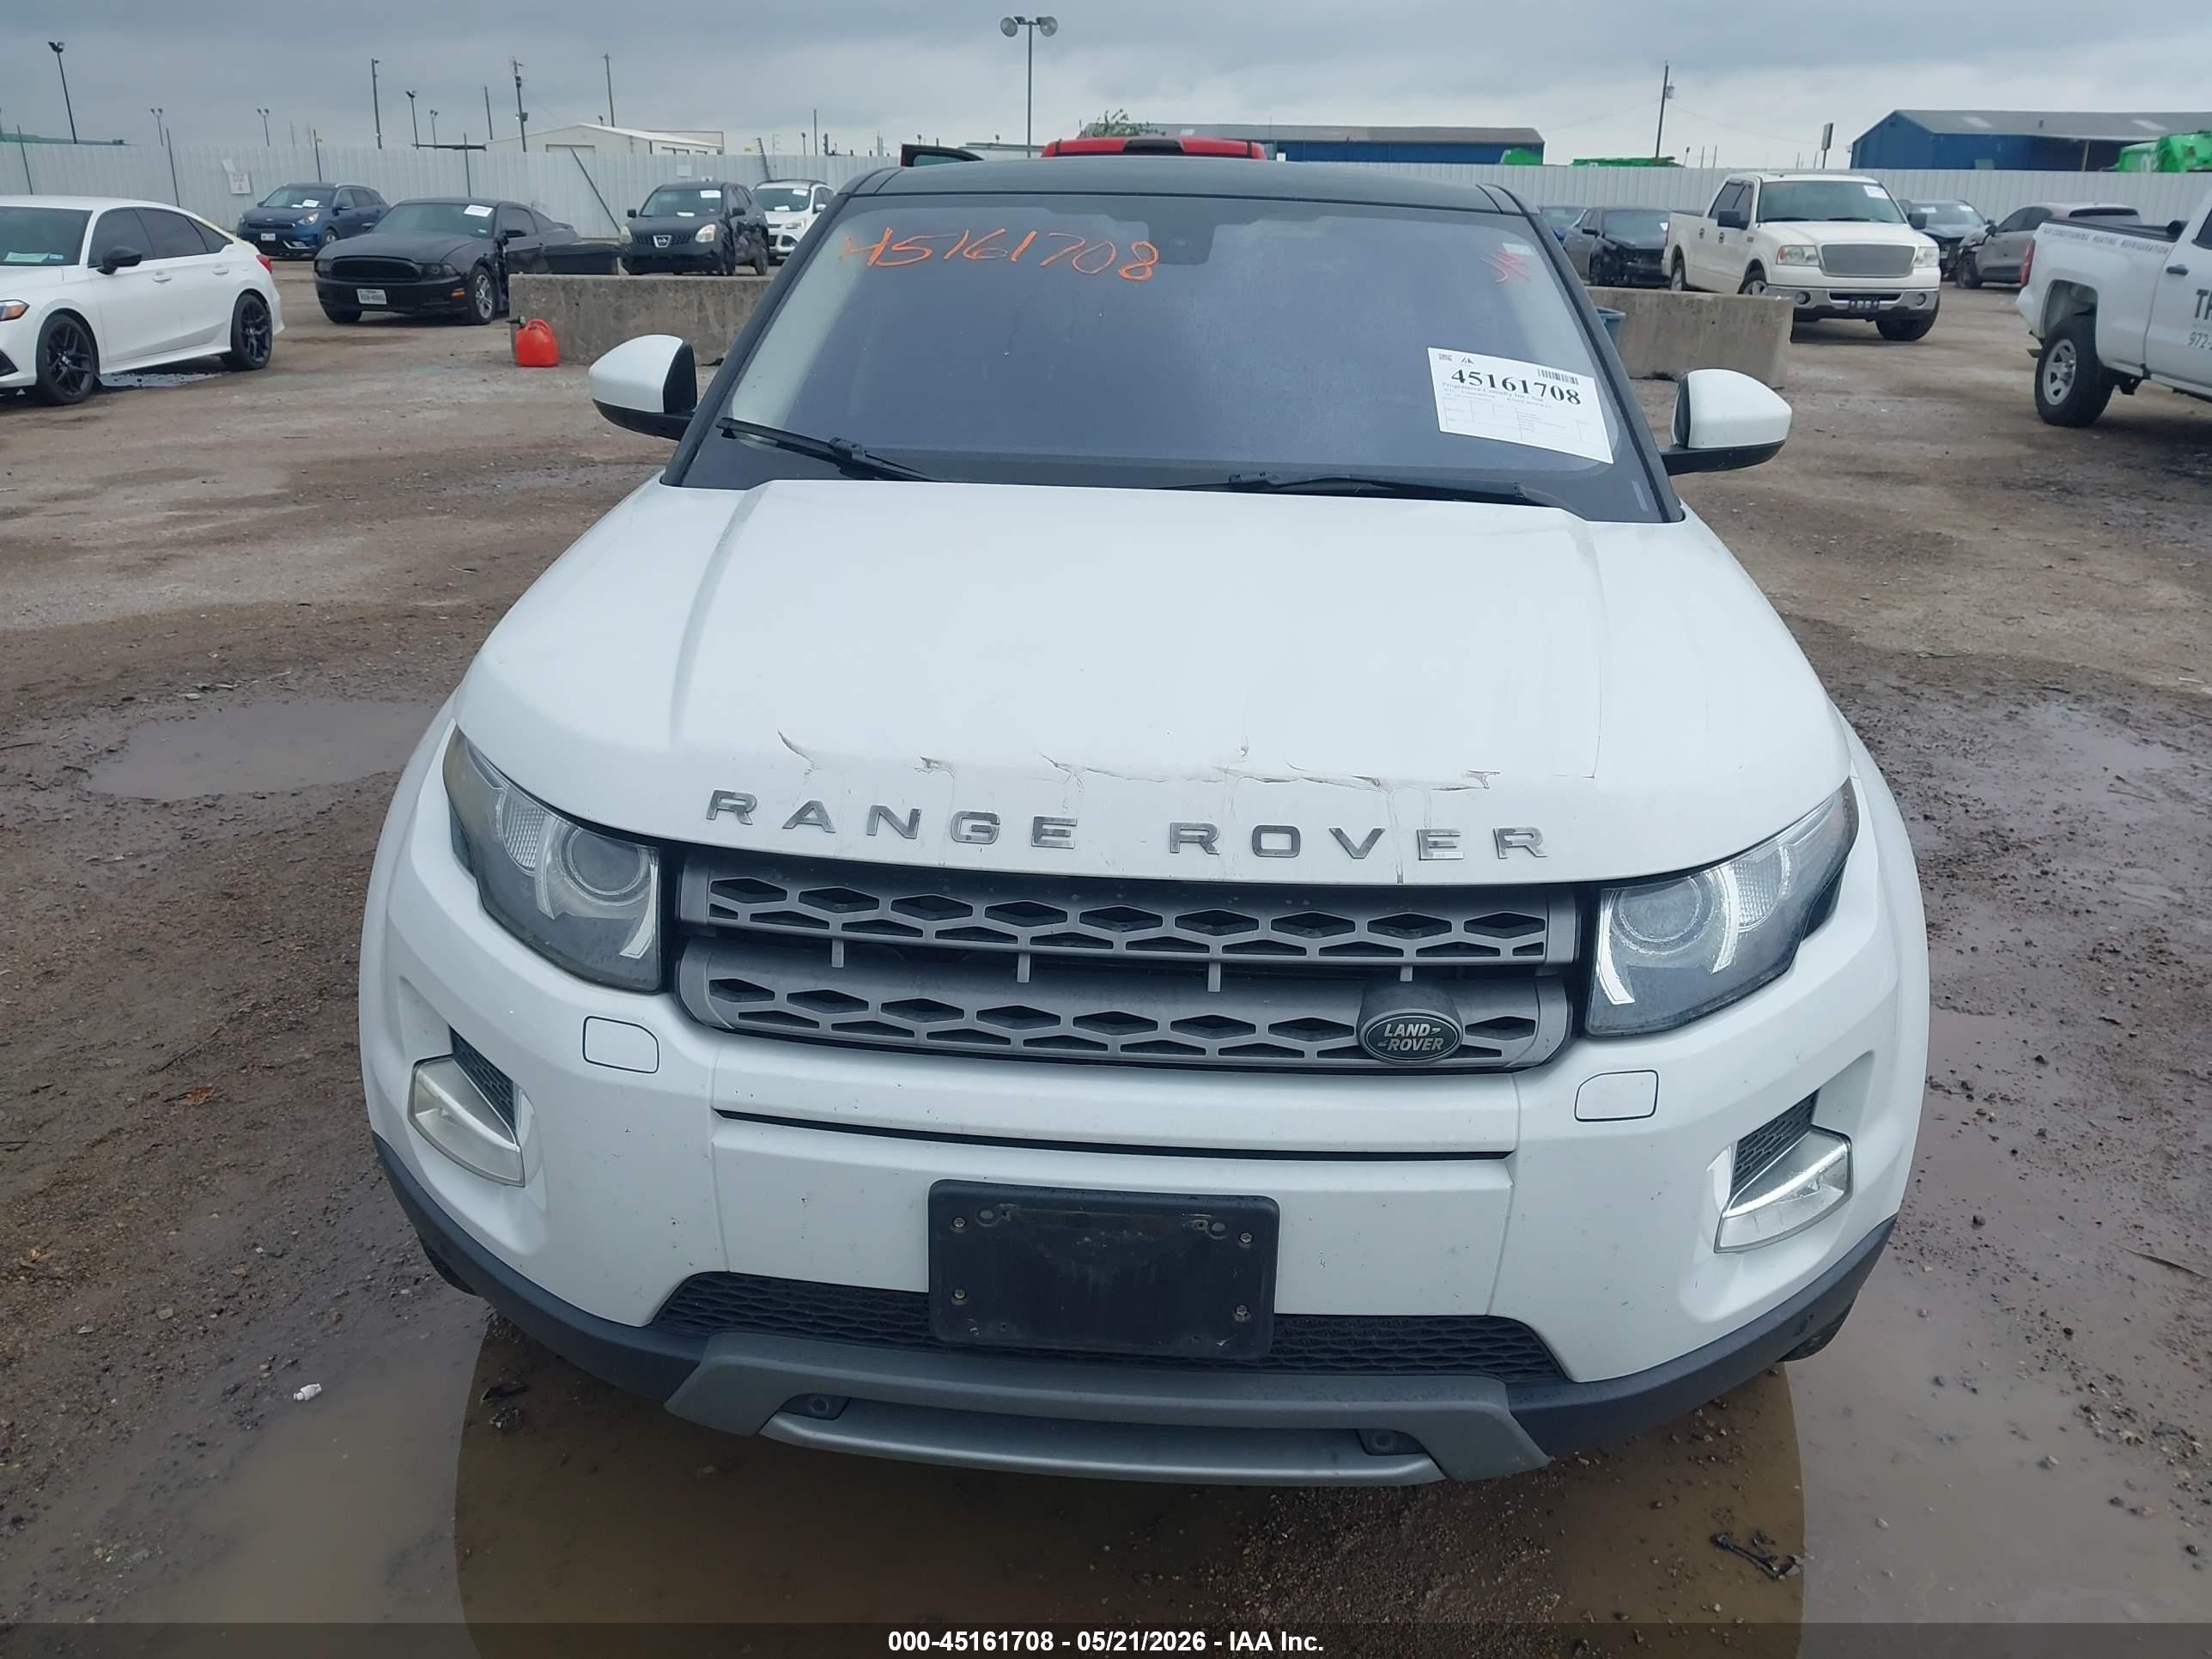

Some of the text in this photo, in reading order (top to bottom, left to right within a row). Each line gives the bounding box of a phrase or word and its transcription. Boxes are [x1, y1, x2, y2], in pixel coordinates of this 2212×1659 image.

[839, 226, 1159, 281] 45161708
[2189, 331, 2212, 350] 972-
[1450, 368, 1582, 405] 45161708
[706, 789, 1548, 861] RANGE ROVER
[1387, 1037, 1443, 1051] ROVER
